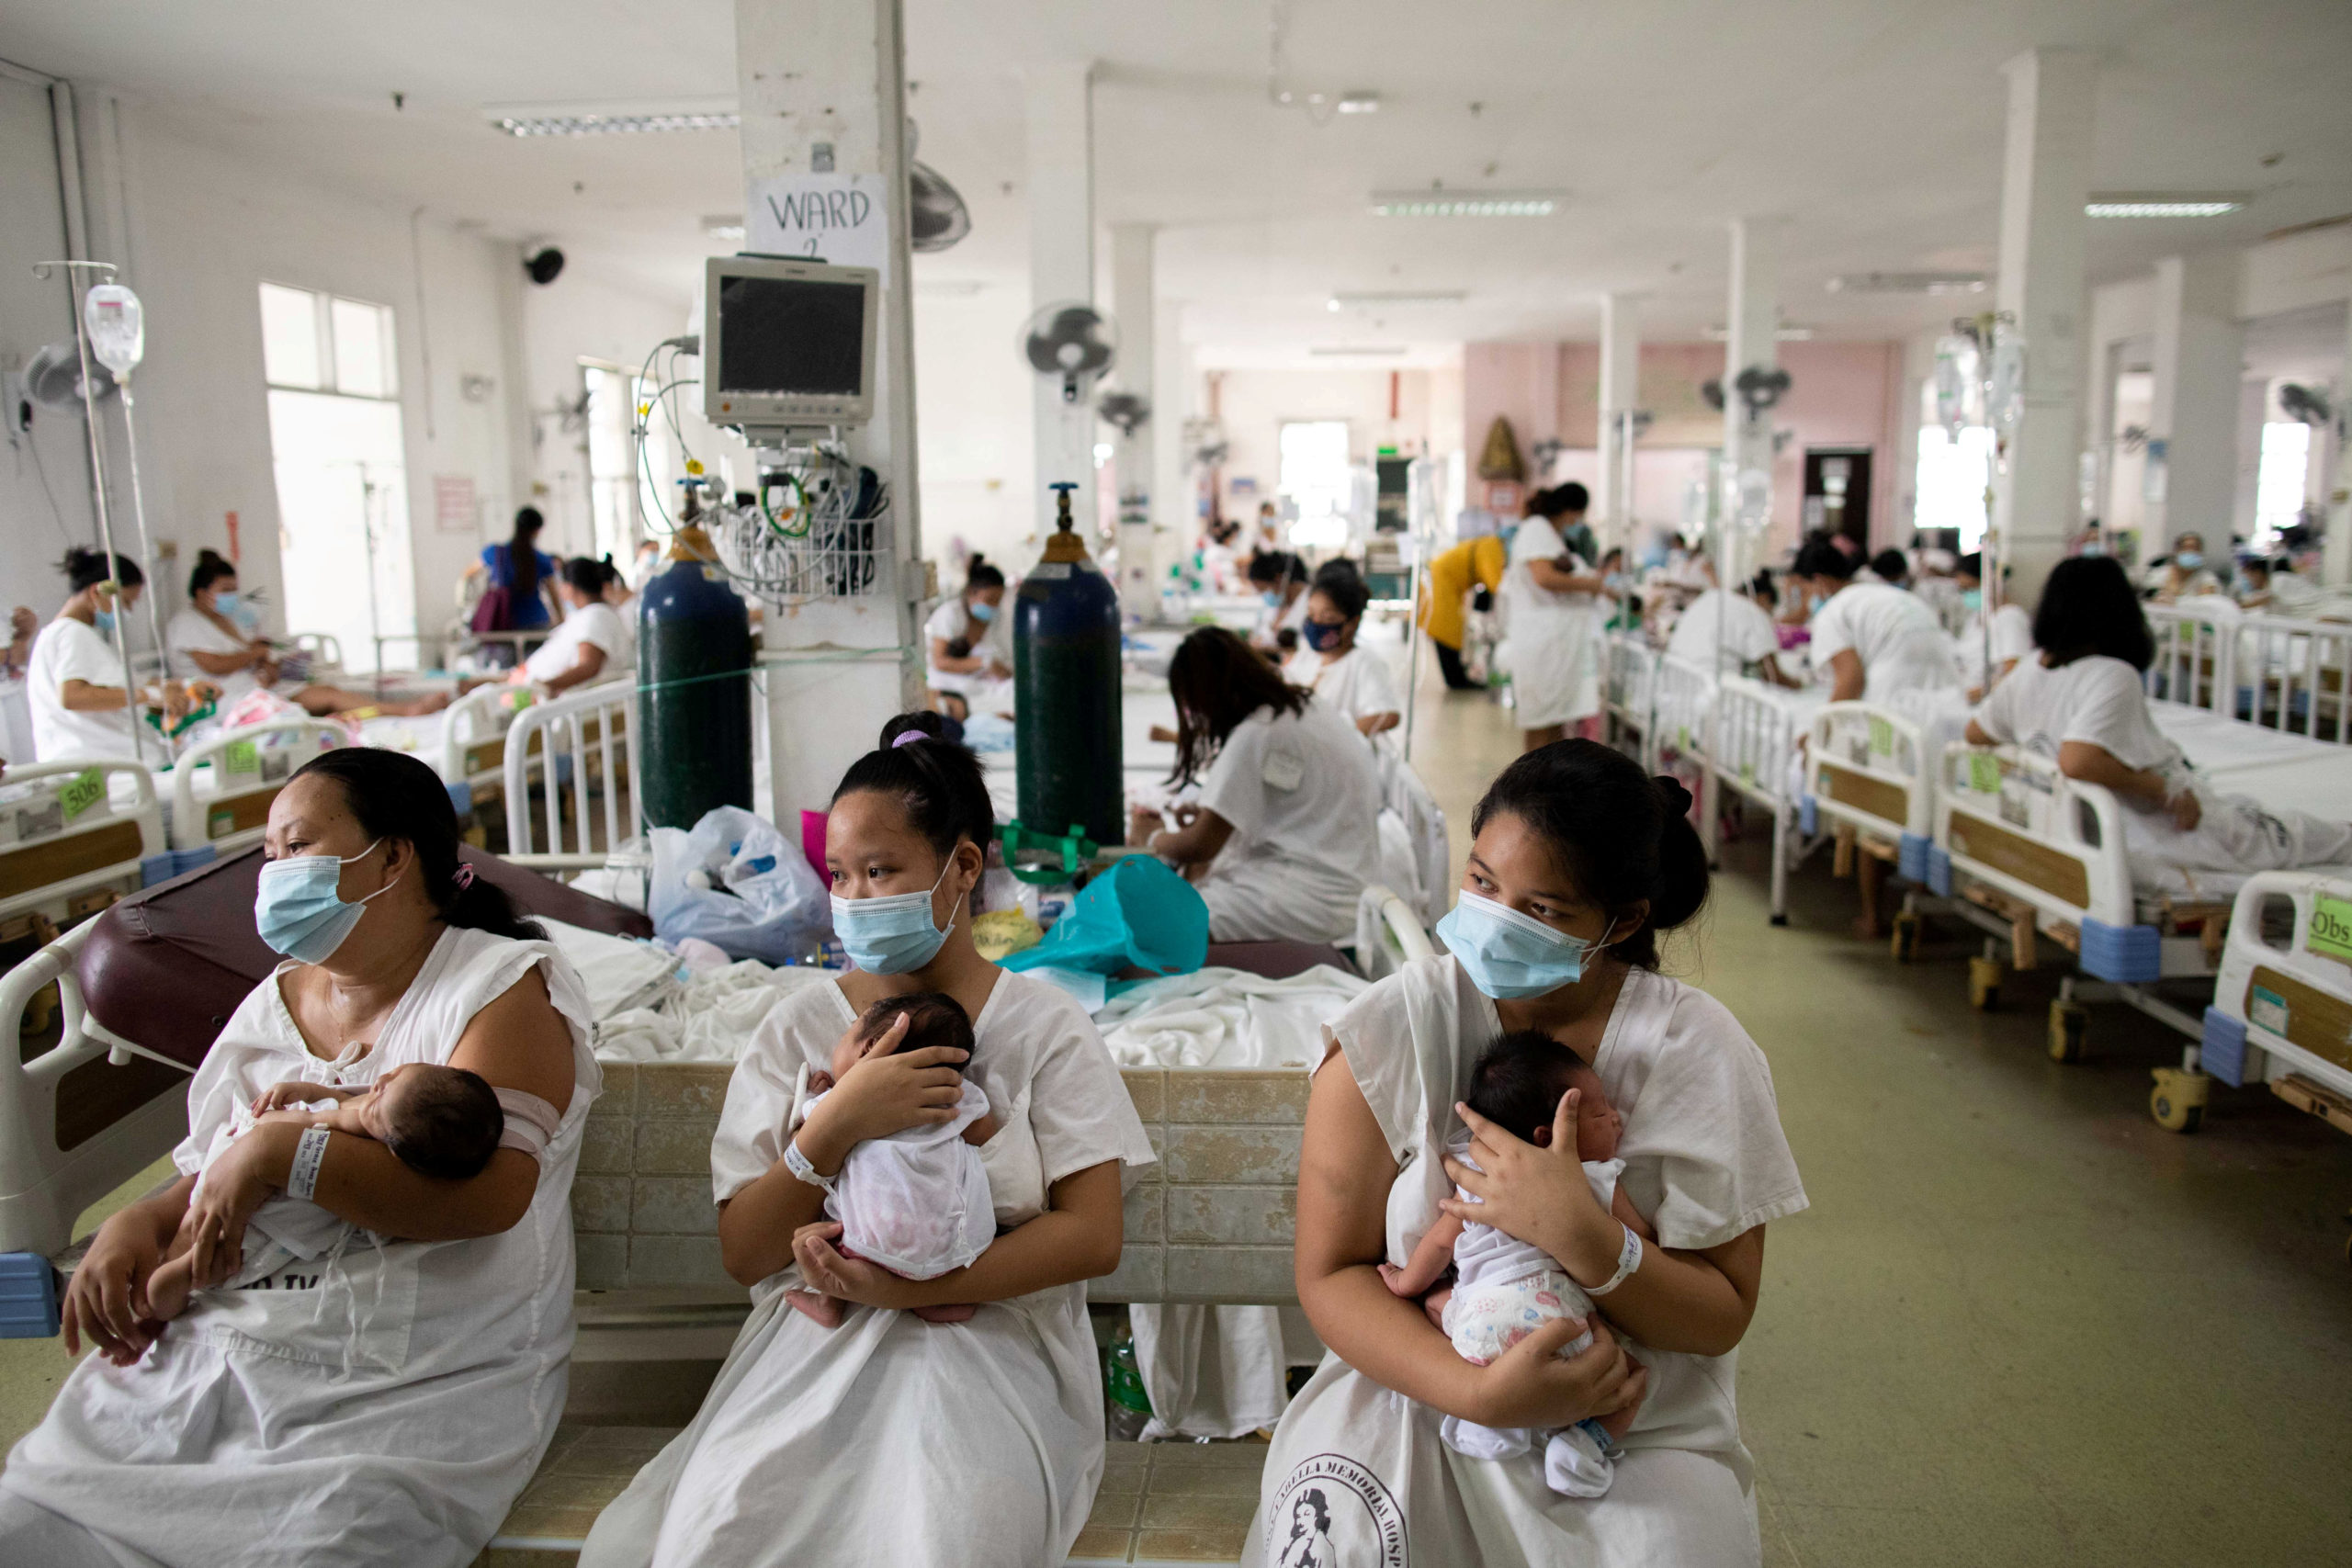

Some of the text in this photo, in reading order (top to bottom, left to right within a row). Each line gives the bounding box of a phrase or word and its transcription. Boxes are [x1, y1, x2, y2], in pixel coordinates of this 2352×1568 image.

[766, 189, 870, 230] WARD
[66, 775, 99, 810] 506
[2311, 909, 2350, 942] Obs
[1324, 1461, 1390, 1521] MEMORIAL
